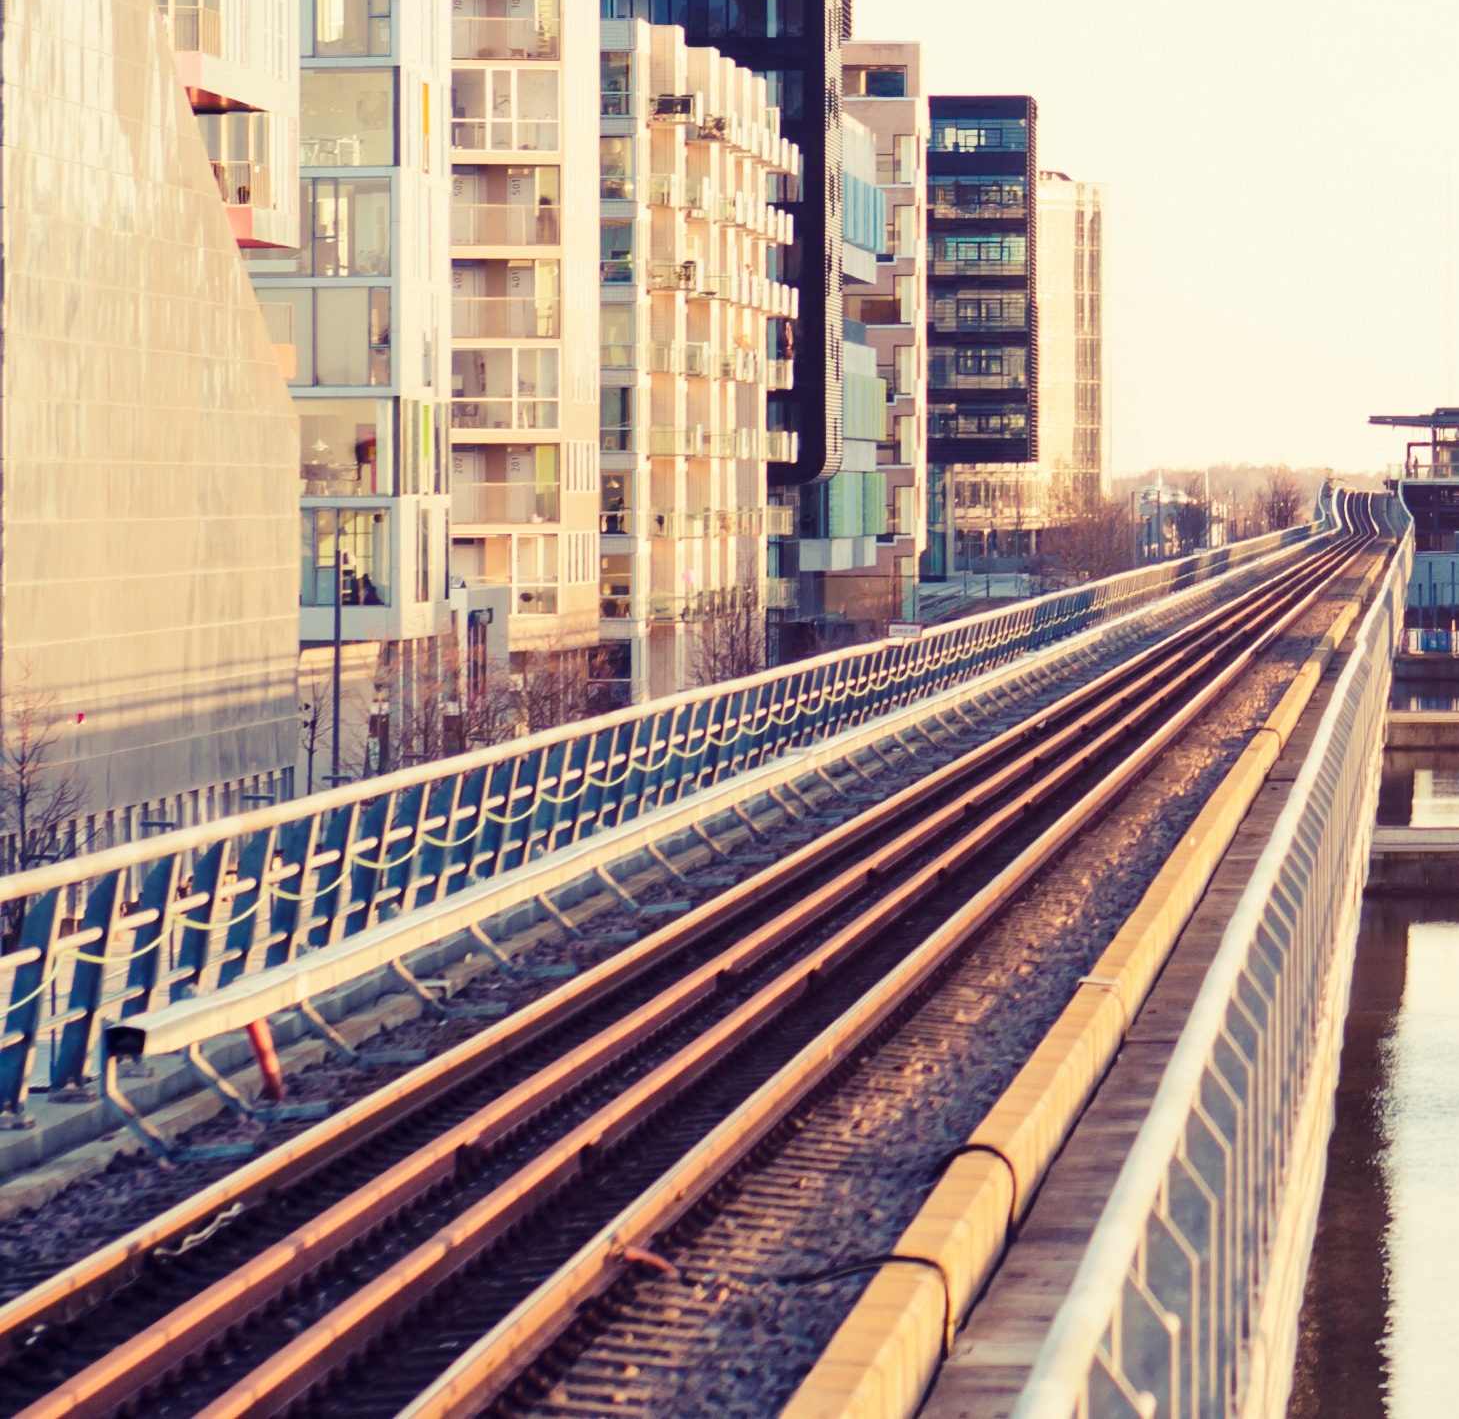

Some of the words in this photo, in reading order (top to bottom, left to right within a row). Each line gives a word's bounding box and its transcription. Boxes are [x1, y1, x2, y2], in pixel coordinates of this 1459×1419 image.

[453, 179, 463, 196] 502
[511, 179, 521, 195] 501
[453, 272, 463, 289] 402
[511, 271, 520, 288] 401
[453, 457, 463, 474] 202
[511, 457, 520, 472] 201
